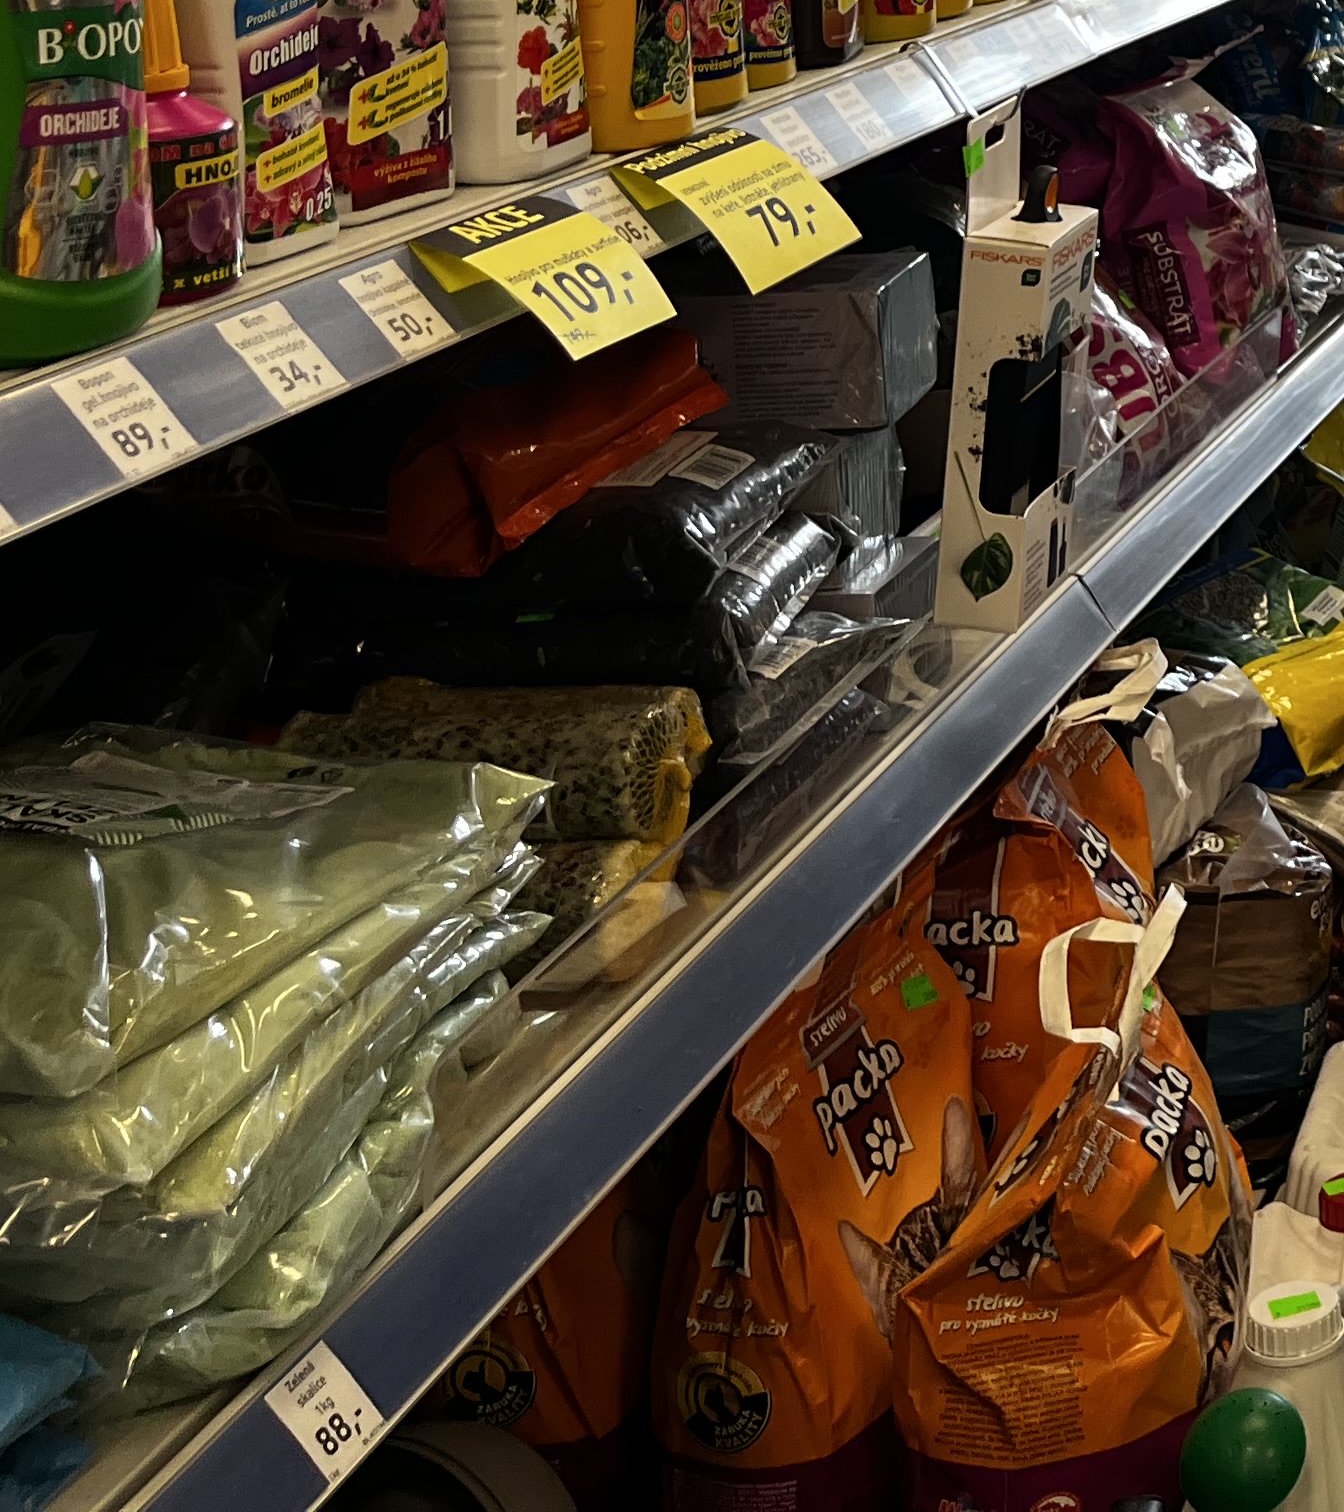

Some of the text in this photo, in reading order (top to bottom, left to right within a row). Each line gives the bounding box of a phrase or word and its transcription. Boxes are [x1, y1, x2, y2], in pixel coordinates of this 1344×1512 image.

[246, 6, 278, 29] Prostě,
[271, 78, 314, 109] bromelie
[40, 106, 120, 138] ORCHIDEJE
[625, 128, 748, 175] Podzimní hnojivo
[387, 167, 427, 184] kompostu
[306, 186, 332, 222] 0,25
[448, 204, 545, 244] AKCE
[746, 196, 816, 247] 79,-
[1052, 227, 1096, 268] FISKARS
[504, 246, 587, 286] Hnojivo muškáty
[532, 259, 637, 322] 109,-
[1138, 232, 1191, 337] SUBSTRÁT
[240, 313, 266, 330] Biom
[387, 313, 435, 344] 50,-
[269, 358, 323, 394] 34,-
[108, 399, 157, 426] orchideje
[112, 420, 172, 458] 89,-
[981, 1040, 1029, 1064] kočky
[816, 1037, 902, 1155] packa
[966, 1292, 1025, 1315] stelivo
[939, 1306, 1059, 1336] pro kočky
[284, 1361, 316, 1394] Zelená
[297, 1374, 327, 1407] skalice
[314, 1395, 336, 1416] 1kg
[314, 1407, 364, 1457] 88,-
[715, 1413, 764, 1450] KVALITY
